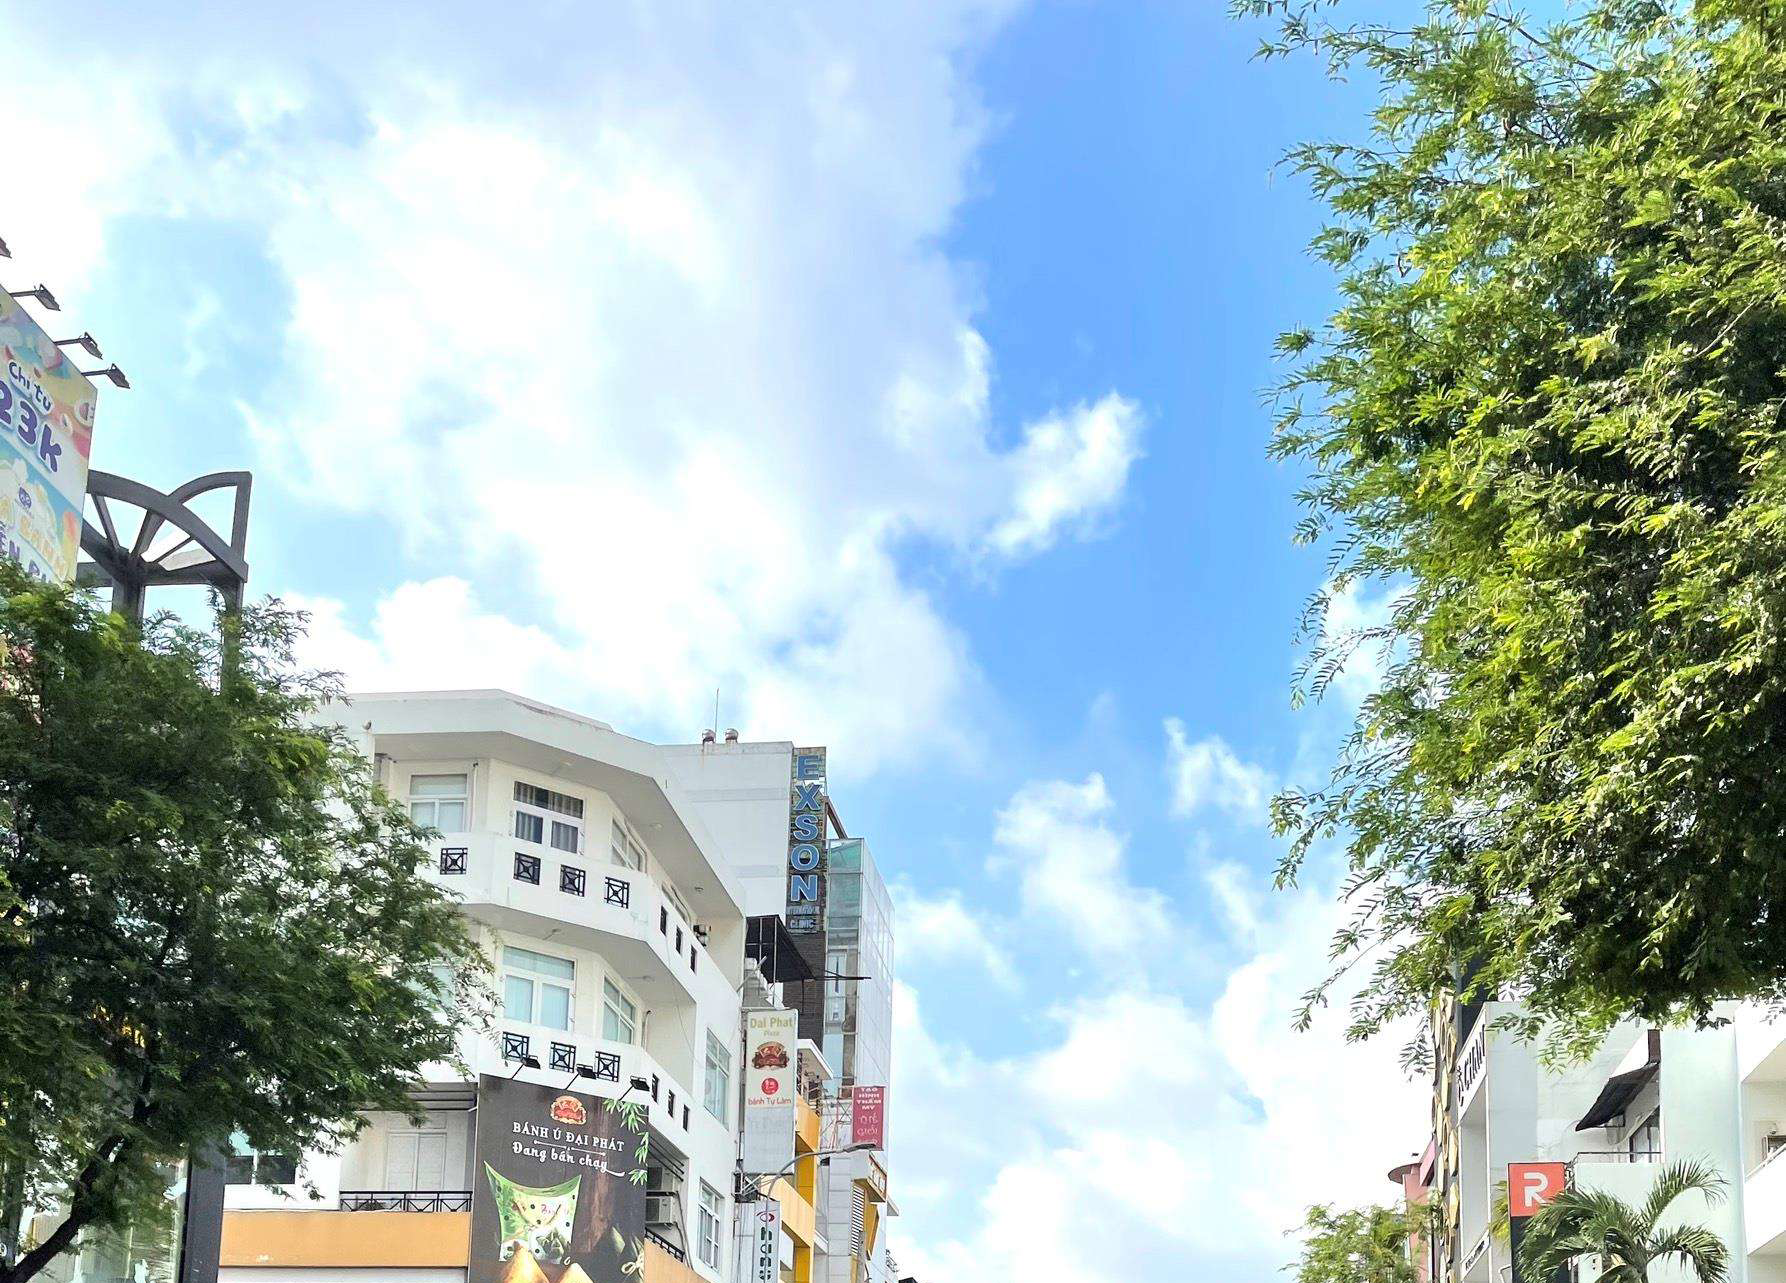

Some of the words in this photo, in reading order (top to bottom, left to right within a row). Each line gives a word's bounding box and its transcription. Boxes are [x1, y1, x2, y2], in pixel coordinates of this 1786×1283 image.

[790, 755, 822, 902] EXSON
[512, 1121, 549, 1139] BÁNH
[565, 1132, 589, 1146] ĐẠI
[592, 1136, 625, 1152] PHÁT
[512, 1141, 547, 1162] Đang
[551, 1148, 575, 1164] bán
[579, 1154, 626, 1177] chạy
